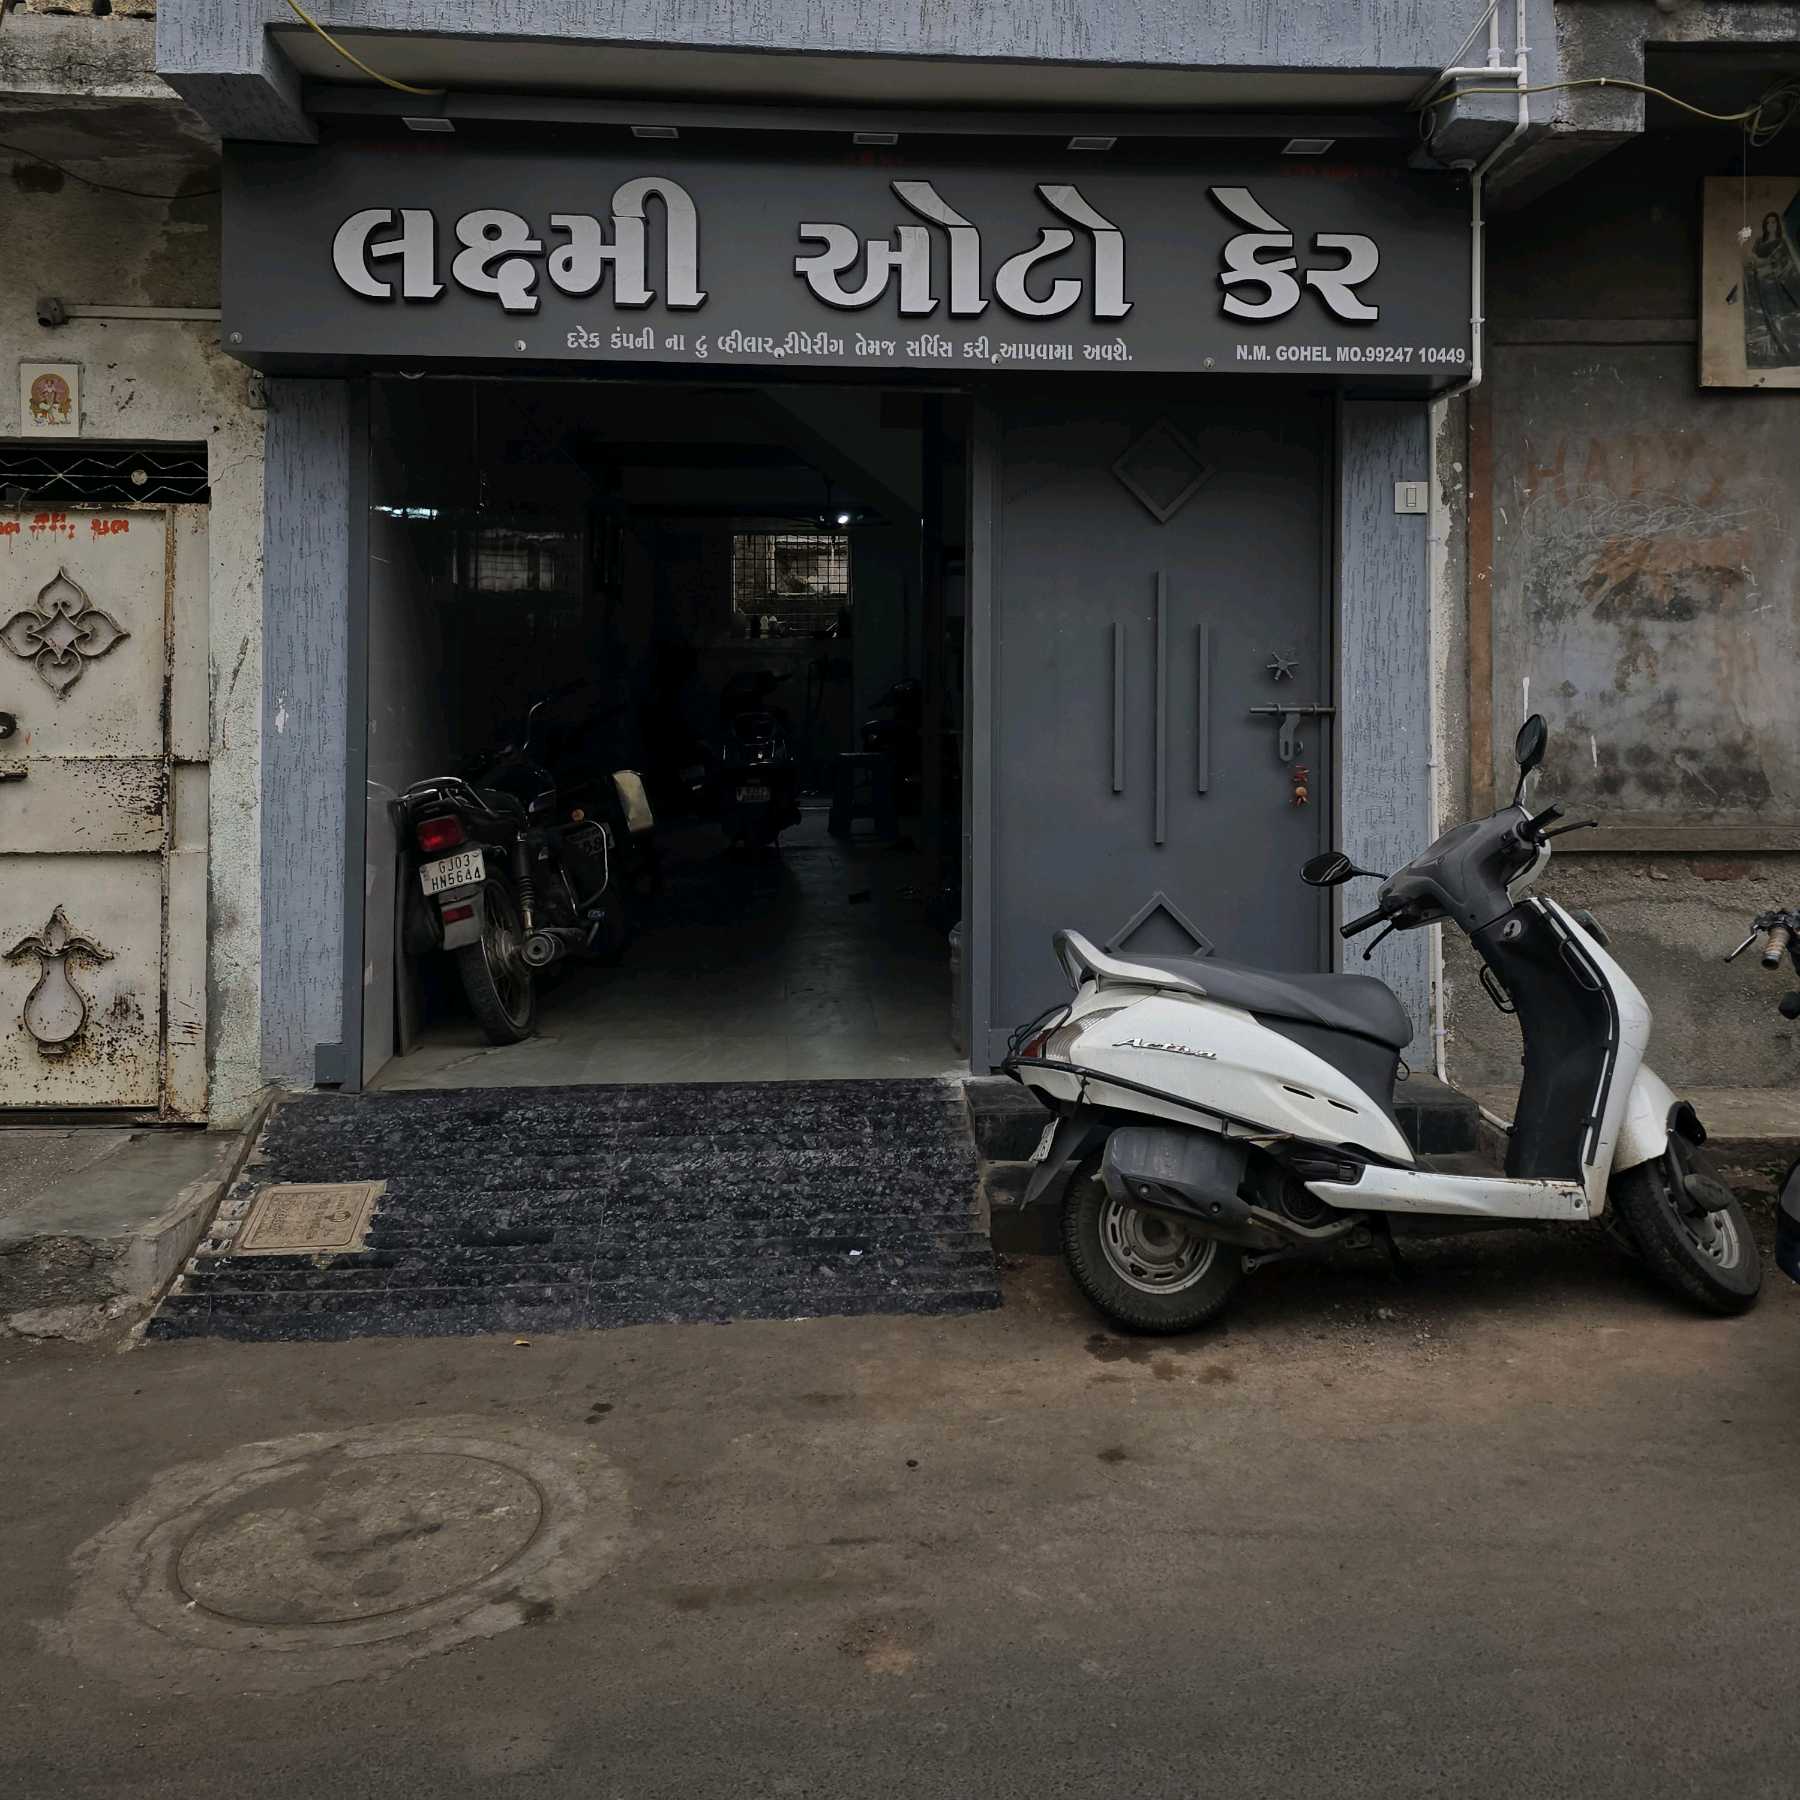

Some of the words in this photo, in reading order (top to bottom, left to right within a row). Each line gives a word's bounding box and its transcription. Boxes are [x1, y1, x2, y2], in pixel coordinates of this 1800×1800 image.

[331, 176, 707, 310] લક્ષ્મી
[794, 180, 1132, 318] ઓટો
[1210, 186, 1380, 321] કેર
[566, 325, 601, 349] દરેક
[610, 325, 655, 350] કંપની
[664, 334, 686, 351] ના
[695, 335, 708, 359] ટુ
[855, 332, 897, 357] તેમજ
[905, 333, 953, 358] સર્વિસ
[963, 335, 990, 359] કરી
[999, 342, 1073, 361] આપવામા
[1236, 344, 1271, 361] N.M.
[1275, 345, 1332, 362] GOHEL
[1336, 346, 1414, 363] MO.99247
[1418, 347, 1465, 364] 10449
[439, 854, 471, 874] GJ03
